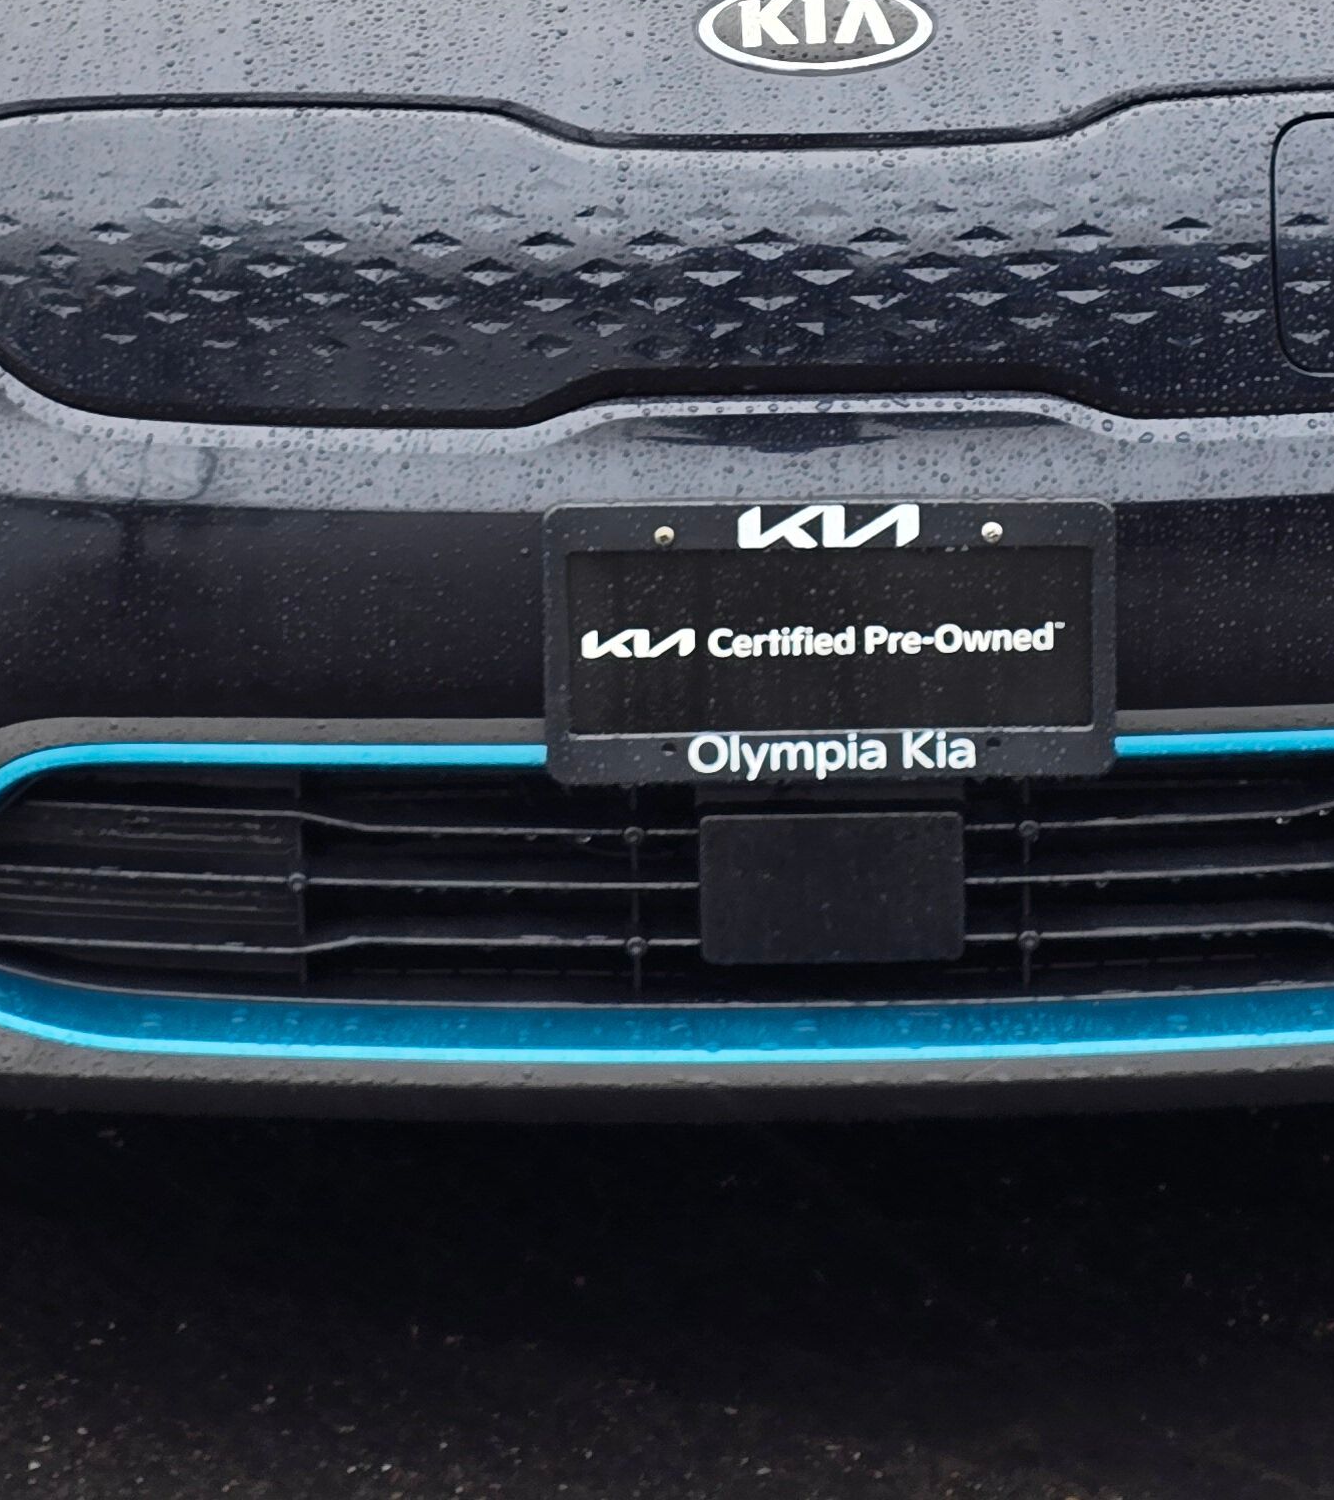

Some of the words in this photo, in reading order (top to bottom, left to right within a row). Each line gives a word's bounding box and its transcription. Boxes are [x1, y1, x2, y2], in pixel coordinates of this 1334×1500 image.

[737, 503, 921, 549] KIA
[581, 627, 696, 660] KIA
[707, 625, 856, 660] Certified
[687, 734, 888, 782] Olympia
[902, 734, 978, 771] Kia
